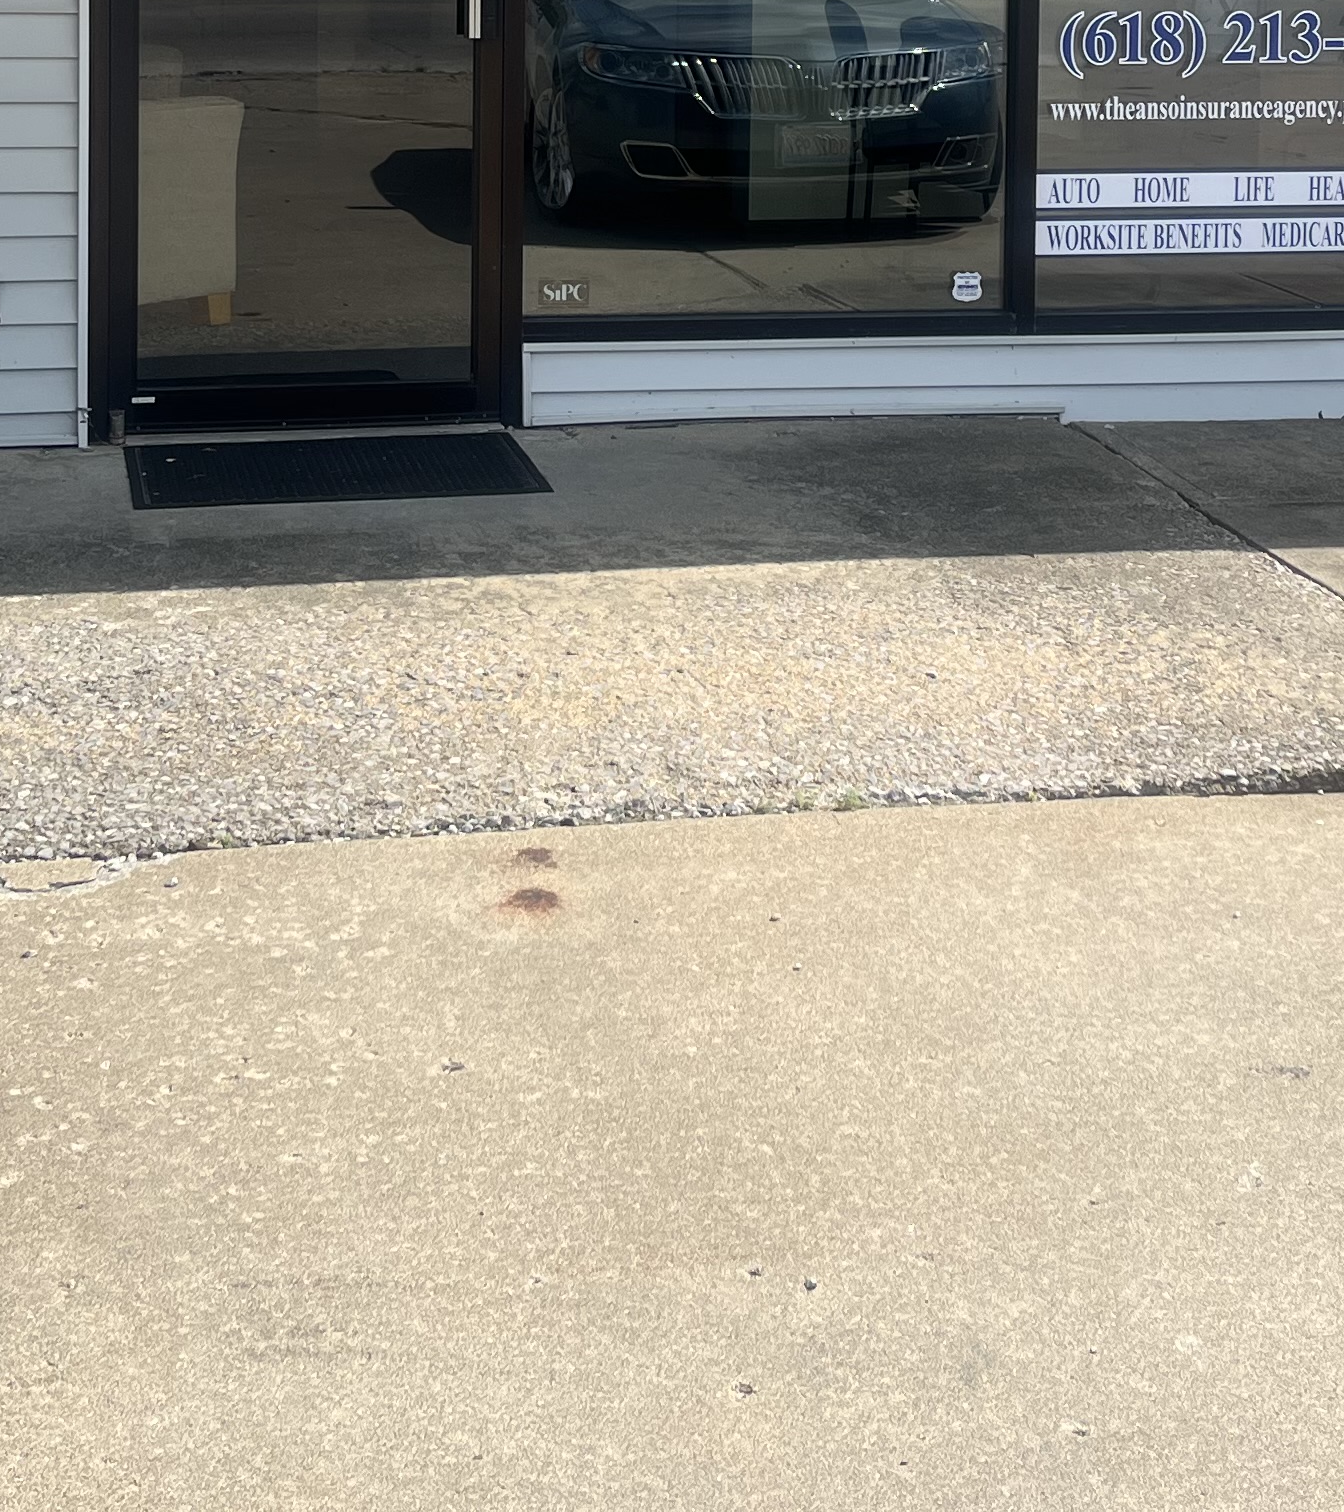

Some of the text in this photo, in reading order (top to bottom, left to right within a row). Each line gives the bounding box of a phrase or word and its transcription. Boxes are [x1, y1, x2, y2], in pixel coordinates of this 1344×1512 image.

[1059, 10, 1207, 79] (618)
[1047, 178, 1101, 204] AUTO
[1133, 176, 1190, 203] HOME
[1233, 176, 1275, 202] LIFE
[1047, 223, 1148, 251] WORKSITE
[1153, 222, 1242, 250] BENEFITS
